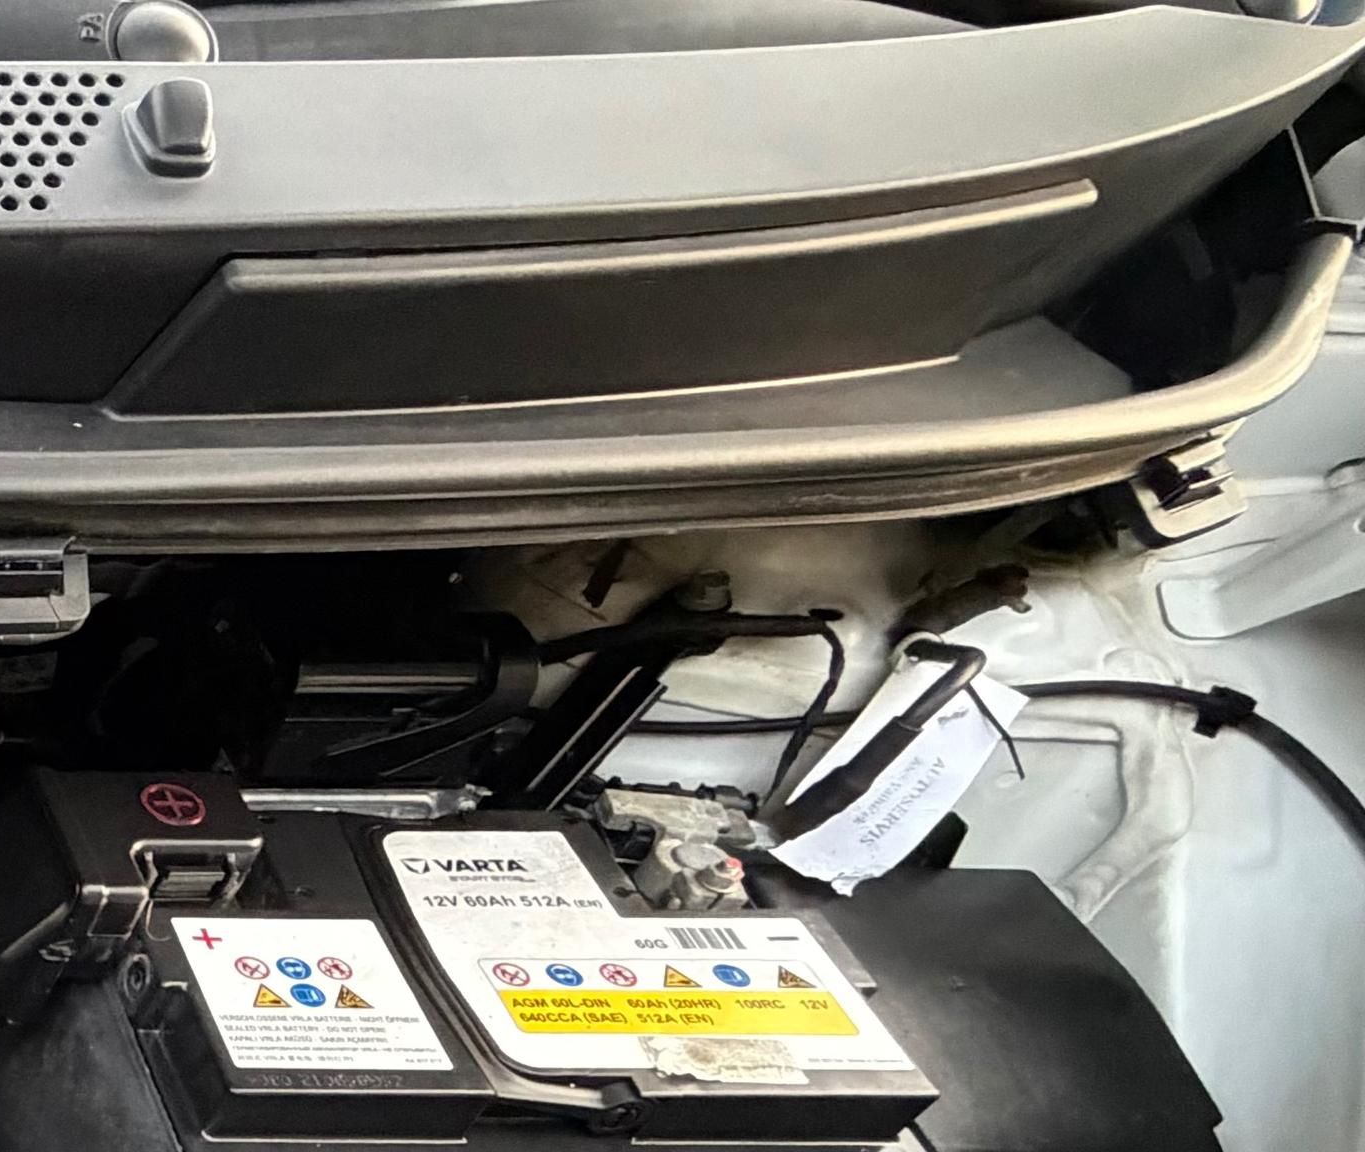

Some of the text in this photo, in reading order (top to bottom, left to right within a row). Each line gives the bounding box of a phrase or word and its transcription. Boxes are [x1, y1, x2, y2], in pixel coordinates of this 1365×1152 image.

[861, 756, 945, 846] AUTOSERVIS
[432, 859, 529, 872] VARTA
[424, 895, 457, 907] 12V
[464, 895, 514, 907] 60Ah
[519, 896, 570, 908] 512A
[513, 998, 829, 1010] AGM 60L-DIN 60Ah (20HR) 100RC 12V
[519, 1012, 715, 1026] 640CCA (SAE) 512A (EN)
